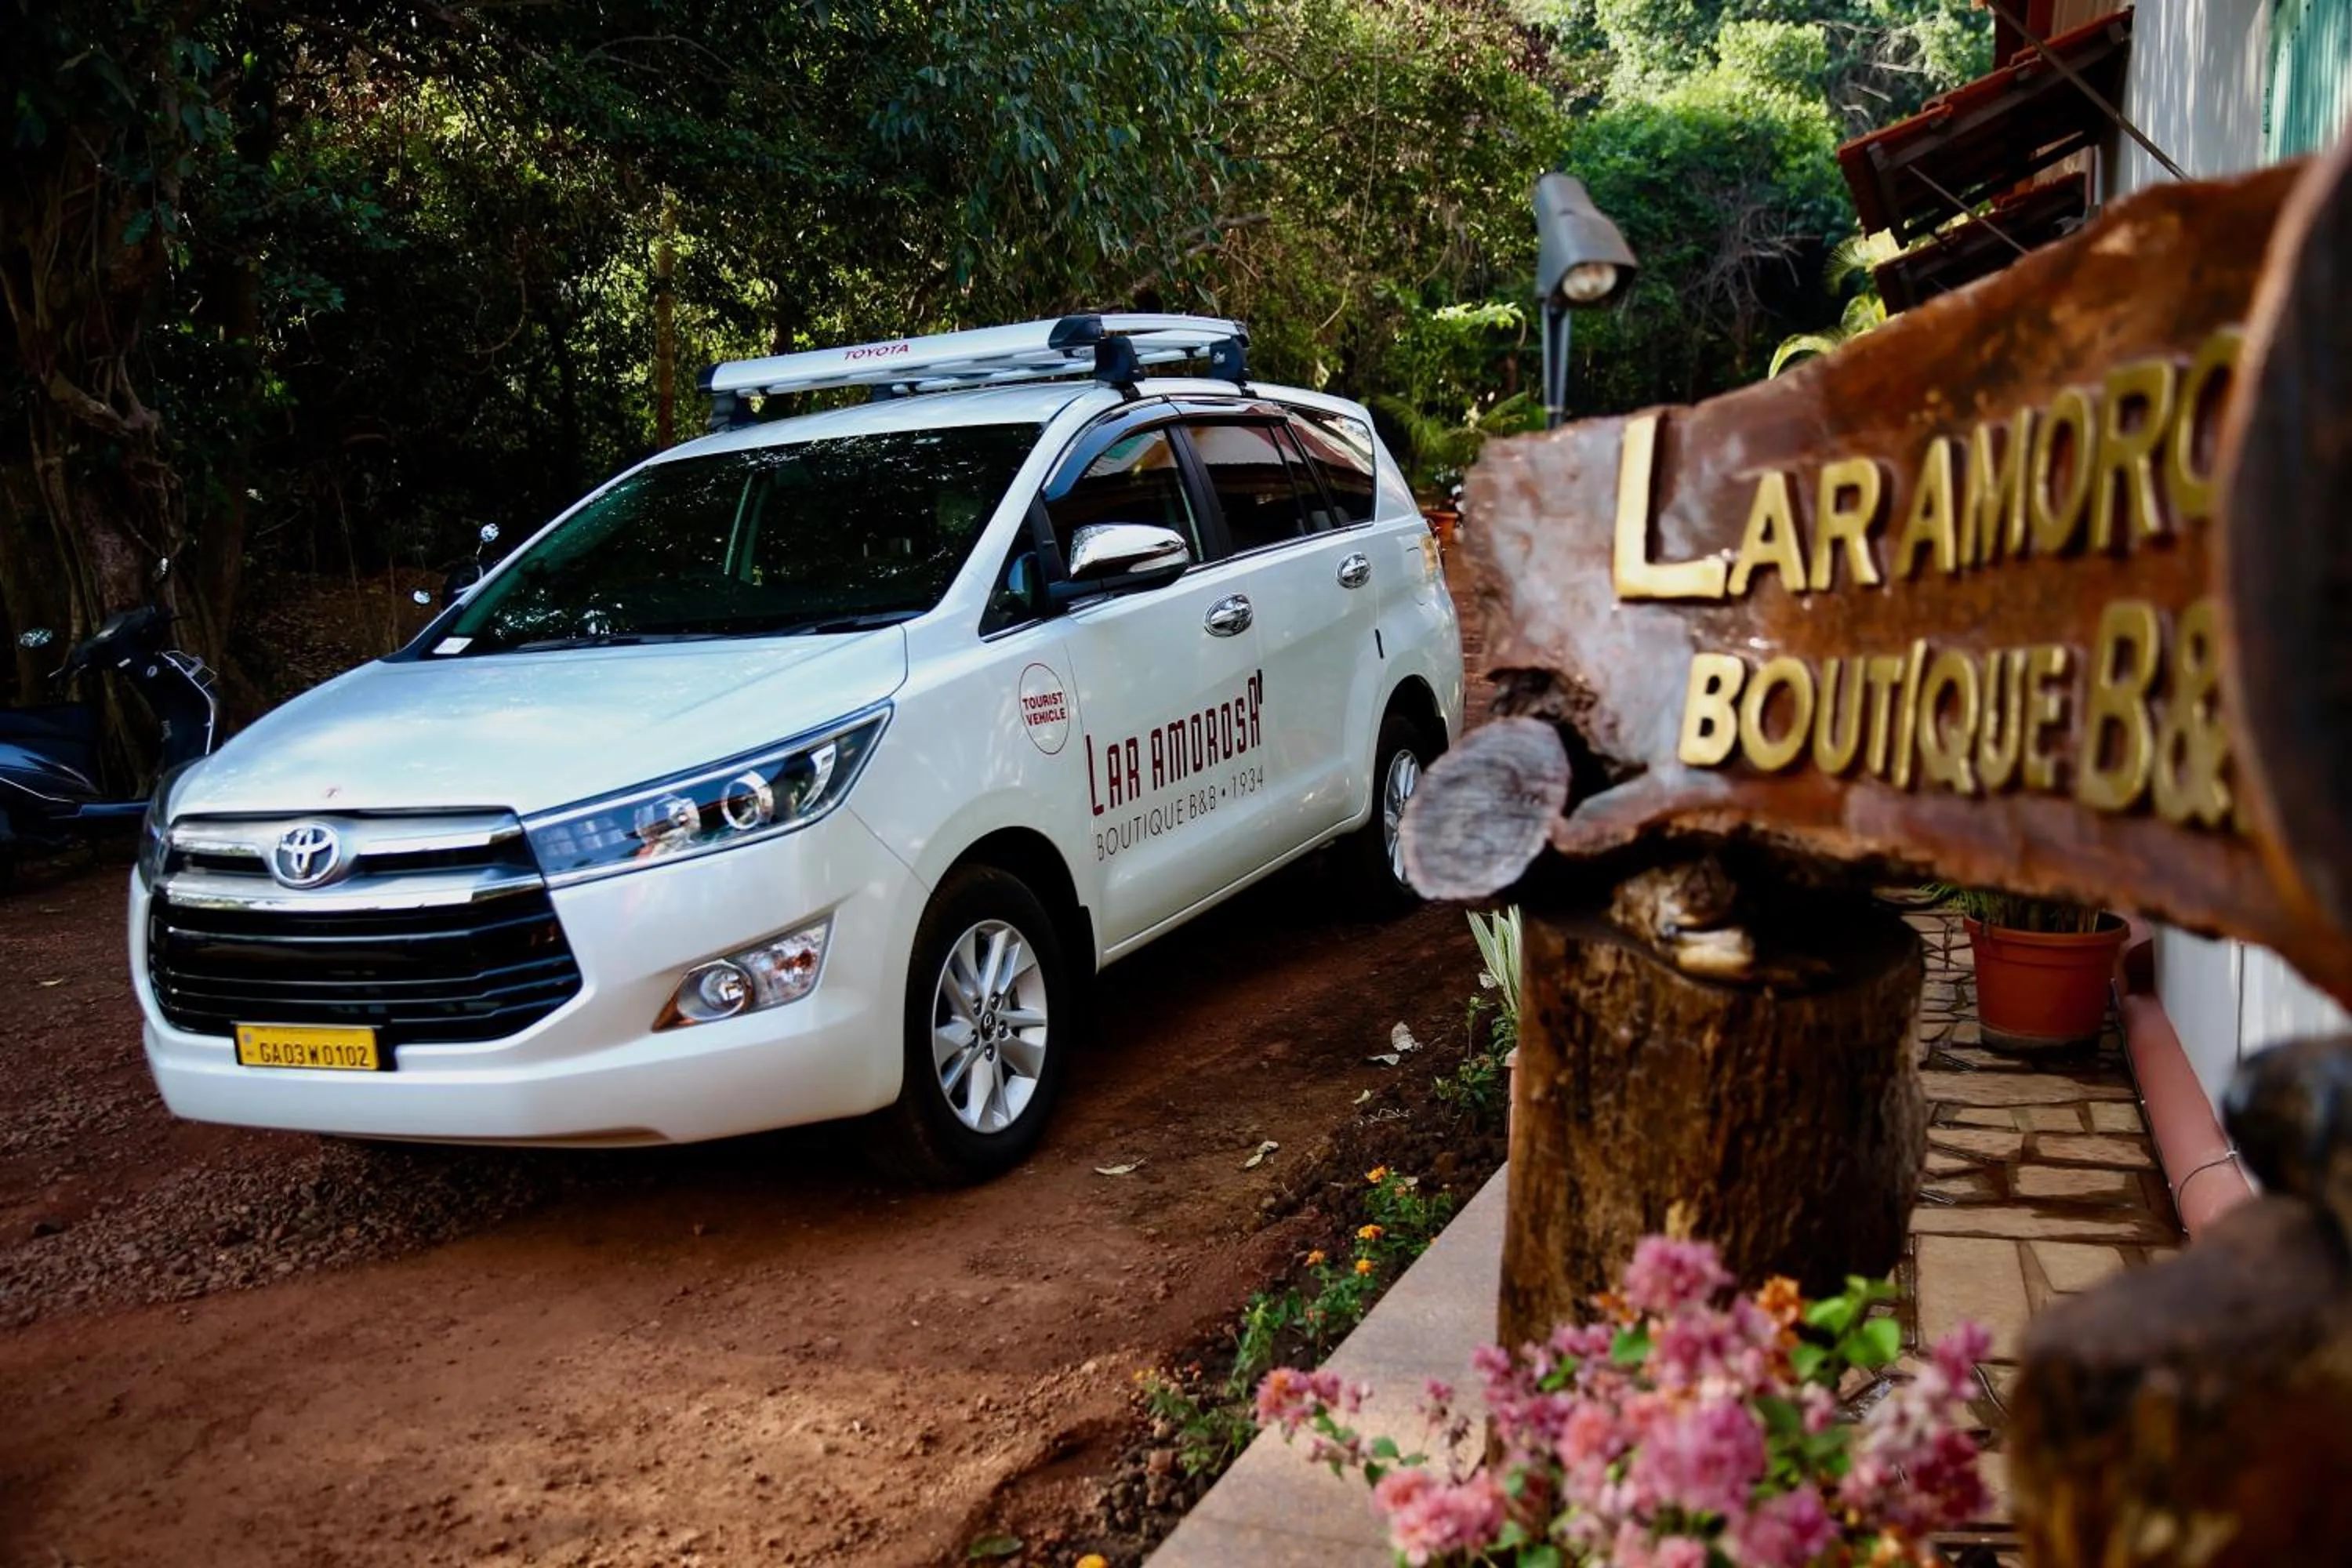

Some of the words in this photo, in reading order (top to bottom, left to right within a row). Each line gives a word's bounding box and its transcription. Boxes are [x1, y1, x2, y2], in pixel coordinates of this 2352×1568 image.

[844, 343, 910, 361] TOYOTA
[1613, 415, 1880, 599] LAR
[1022, 691, 1062, 710] TOURIST
[1025, 707, 1066, 726] VEHICLE
[1086, 734, 1142, 816] LAR
[1150, 669, 1263, 791] AMOROSA
[1677, 637, 2067, 793] BOUTIQUE
[2078, 601, 2245, 831] B&
[1096, 798, 1185, 861] BOUTIQUE
[1189, 785, 1216, 819] B&B
[1231, 764, 1264, 798] 1934
